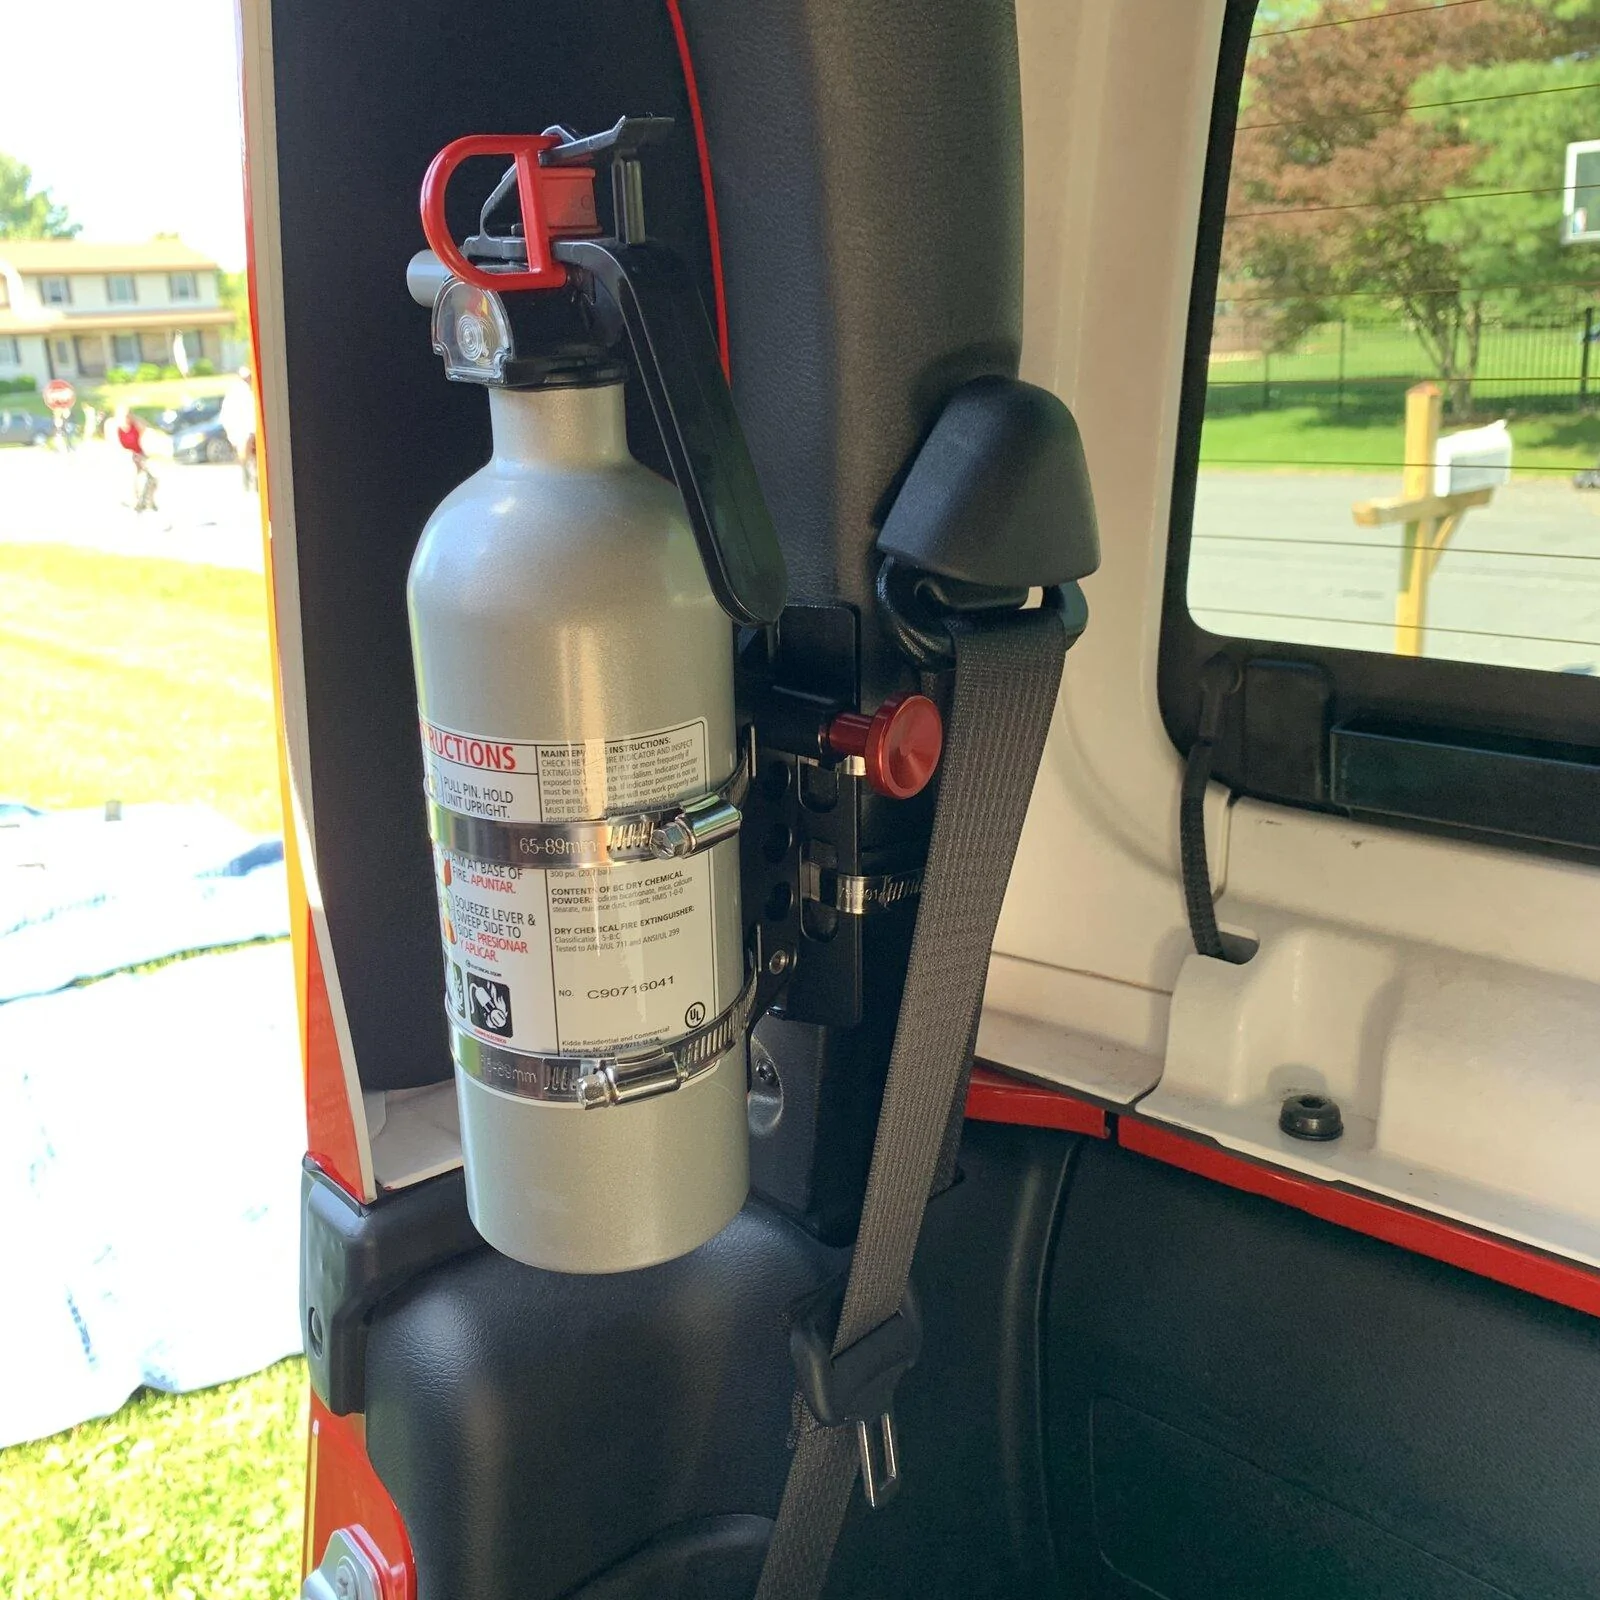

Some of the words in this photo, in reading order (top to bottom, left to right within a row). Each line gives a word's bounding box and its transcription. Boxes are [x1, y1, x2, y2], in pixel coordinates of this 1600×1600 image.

[609, 737, 671, 753] INSTRUCTIONS:
[657, 746, 670, 755] AND
[672, 739, 693, 751] INSPECT
[640, 760, 655, 768] more
[657, 752, 684, 765] frequently
[444, 776, 461, 794] PULL
[463, 783, 481, 799] PIN.
[483, 788, 514, 804] HOLD
[543, 779, 571, 787] exposed
[652, 785, 666, 793] work
[445, 792, 462, 808] UNIT
[465, 799, 510, 818] UPRIGHT.
[520, 838, 597, 854] 65-89mm
[467, 859, 477, 873] AT
[481, 862, 506, 877] BASE
[508, 866, 524, 880] OF
[471, 874, 516, 893] APUNTAR.
[626, 881, 642, 890] DRY
[645, 870, 683, 886] CHEMICAL
[455, 895, 490, 919] SQUEEZE
[492, 907, 524, 925] LEVER
[527, 913, 536, 926] &
[620, 920, 638, 930] FIRE
[640, 905, 695, 927] EXTINGUISHER:
[456, 910, 480, 929] SWEEP
[483, 920, 504, 936] SIDE
[506, 924, 521, 938] TO
[465, 942, 499, 962] APLICAR.
[477, 932, 528, 953] PRESIONAR
[559, 989, 574, 997] NO.
[587, 975, 674, 999] C90716041
[634, 1026, 670, 1039] Commercial
